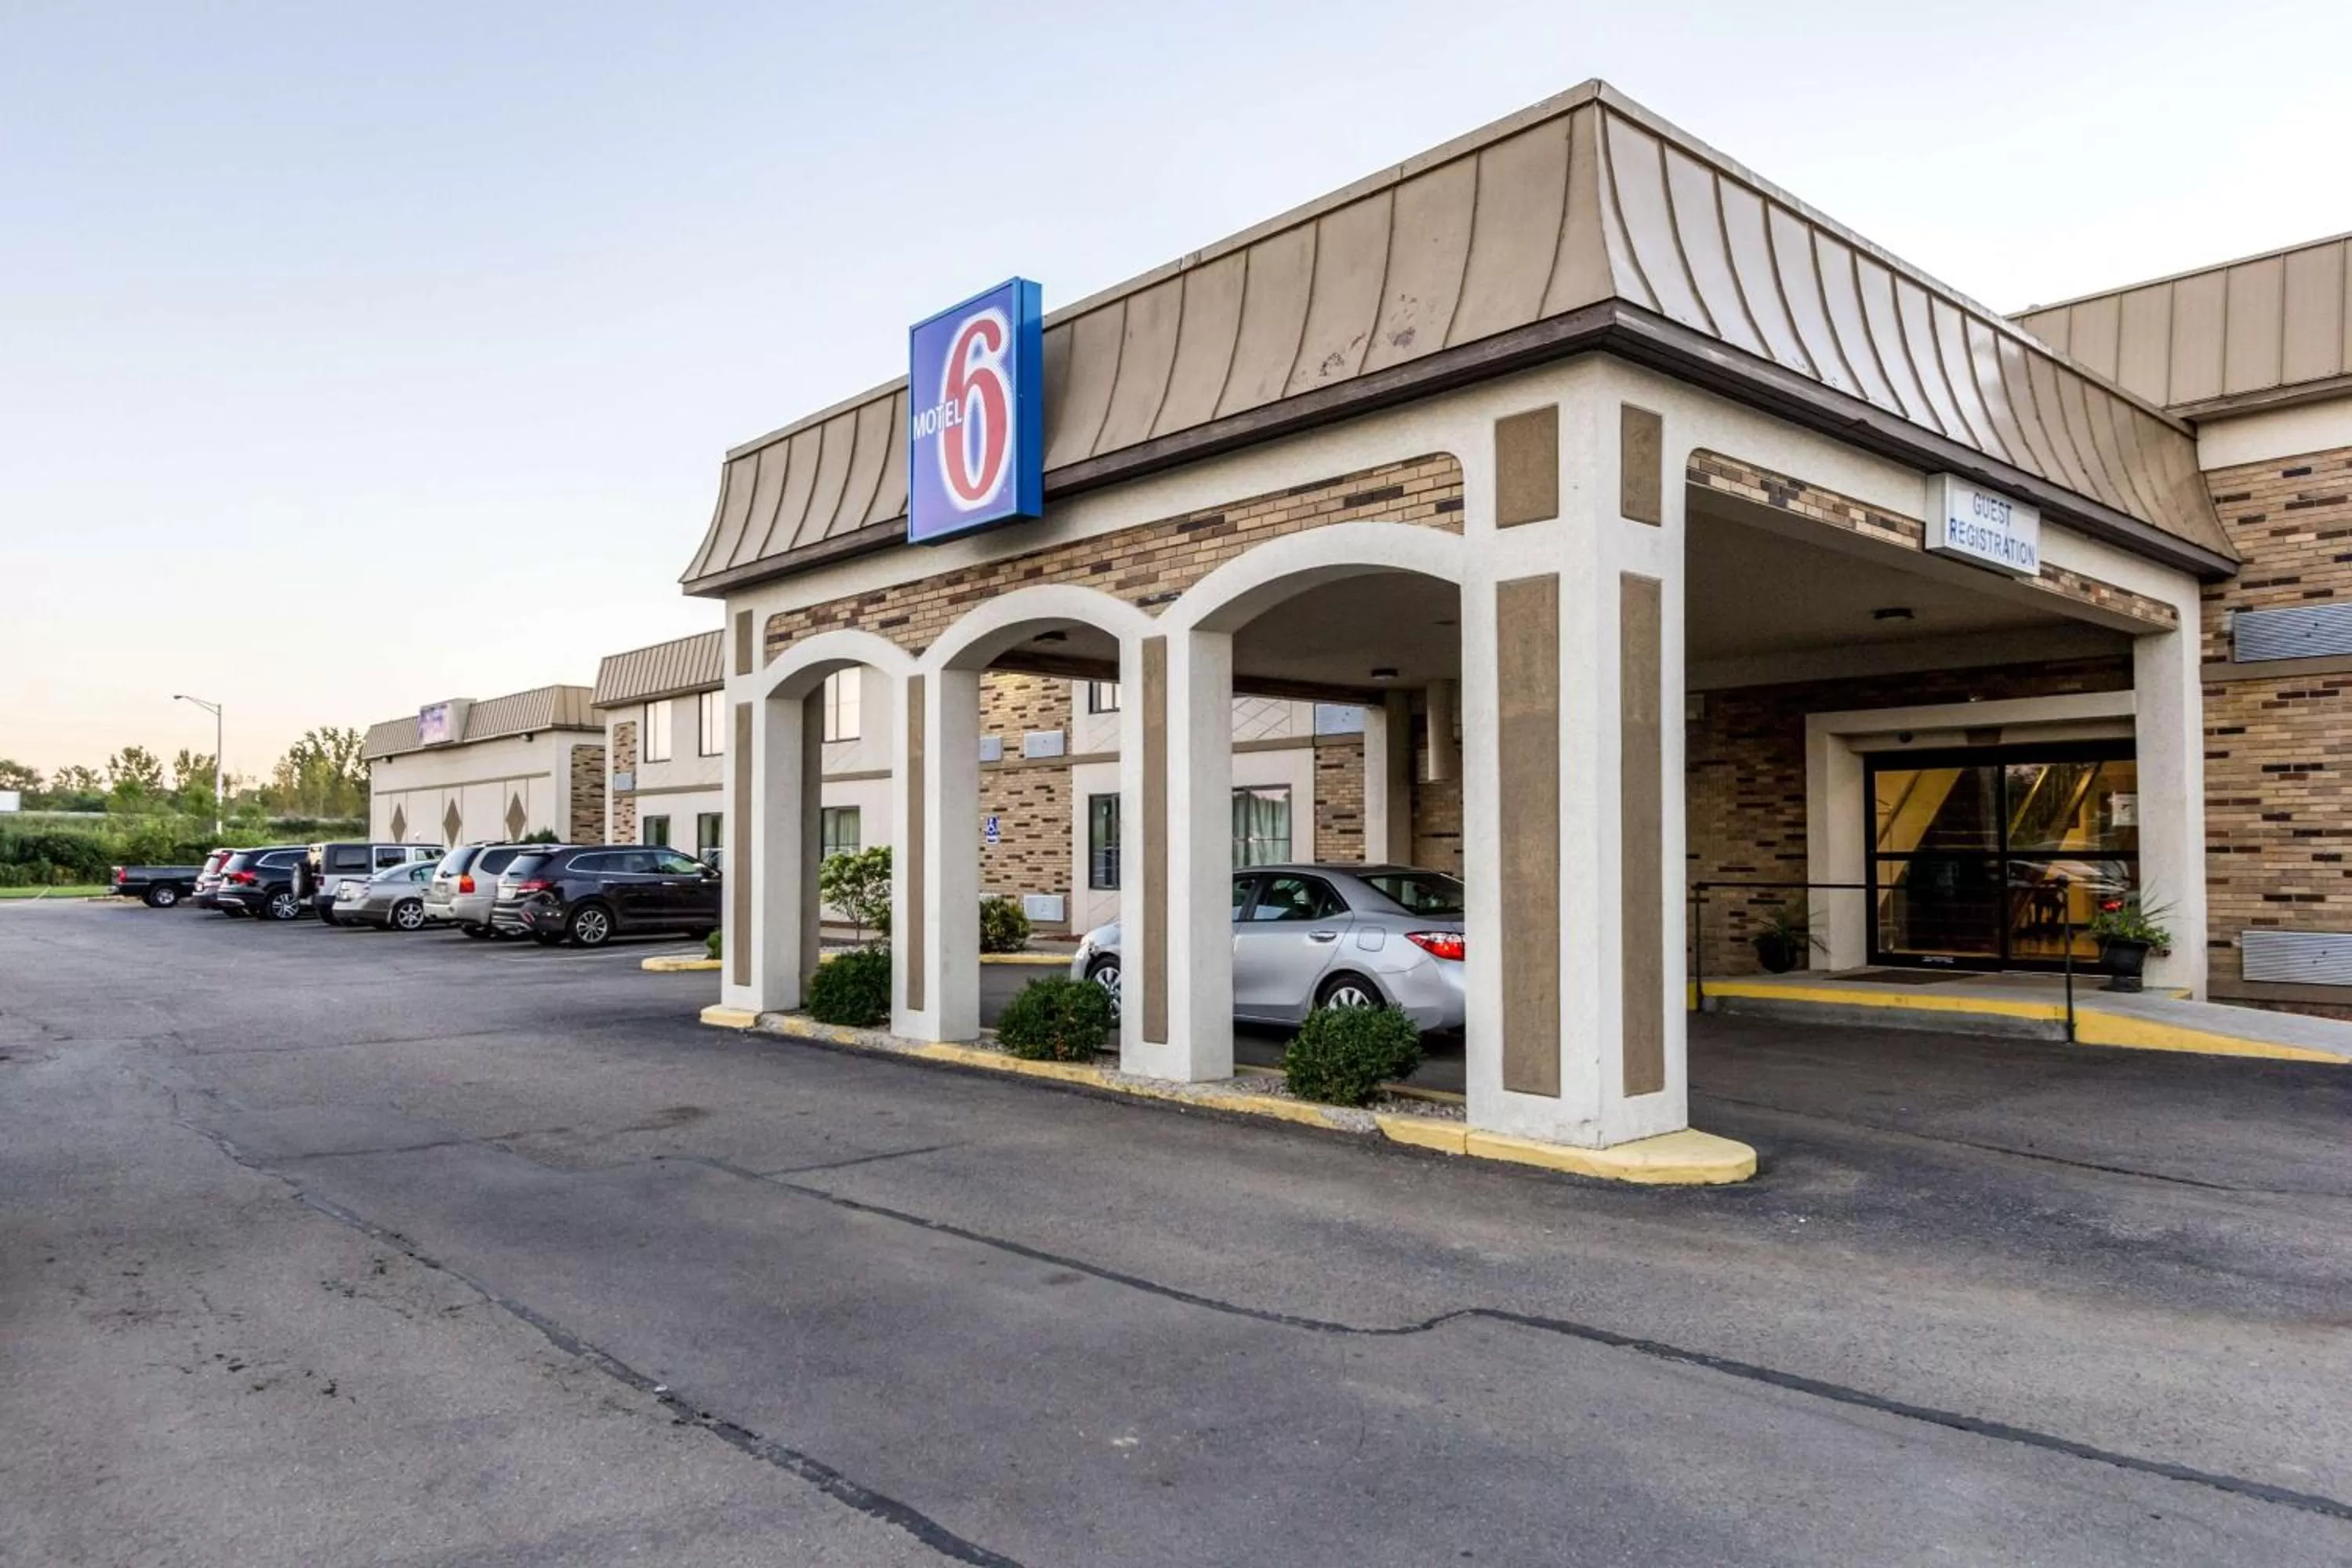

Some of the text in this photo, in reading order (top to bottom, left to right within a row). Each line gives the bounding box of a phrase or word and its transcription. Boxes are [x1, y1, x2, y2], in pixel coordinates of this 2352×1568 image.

[913, 319, 1007, 502] MOTEL 6
[1973, 492, 2012, 527] GUEST
[1950, 517, 2035, 566] REGISTRATION
